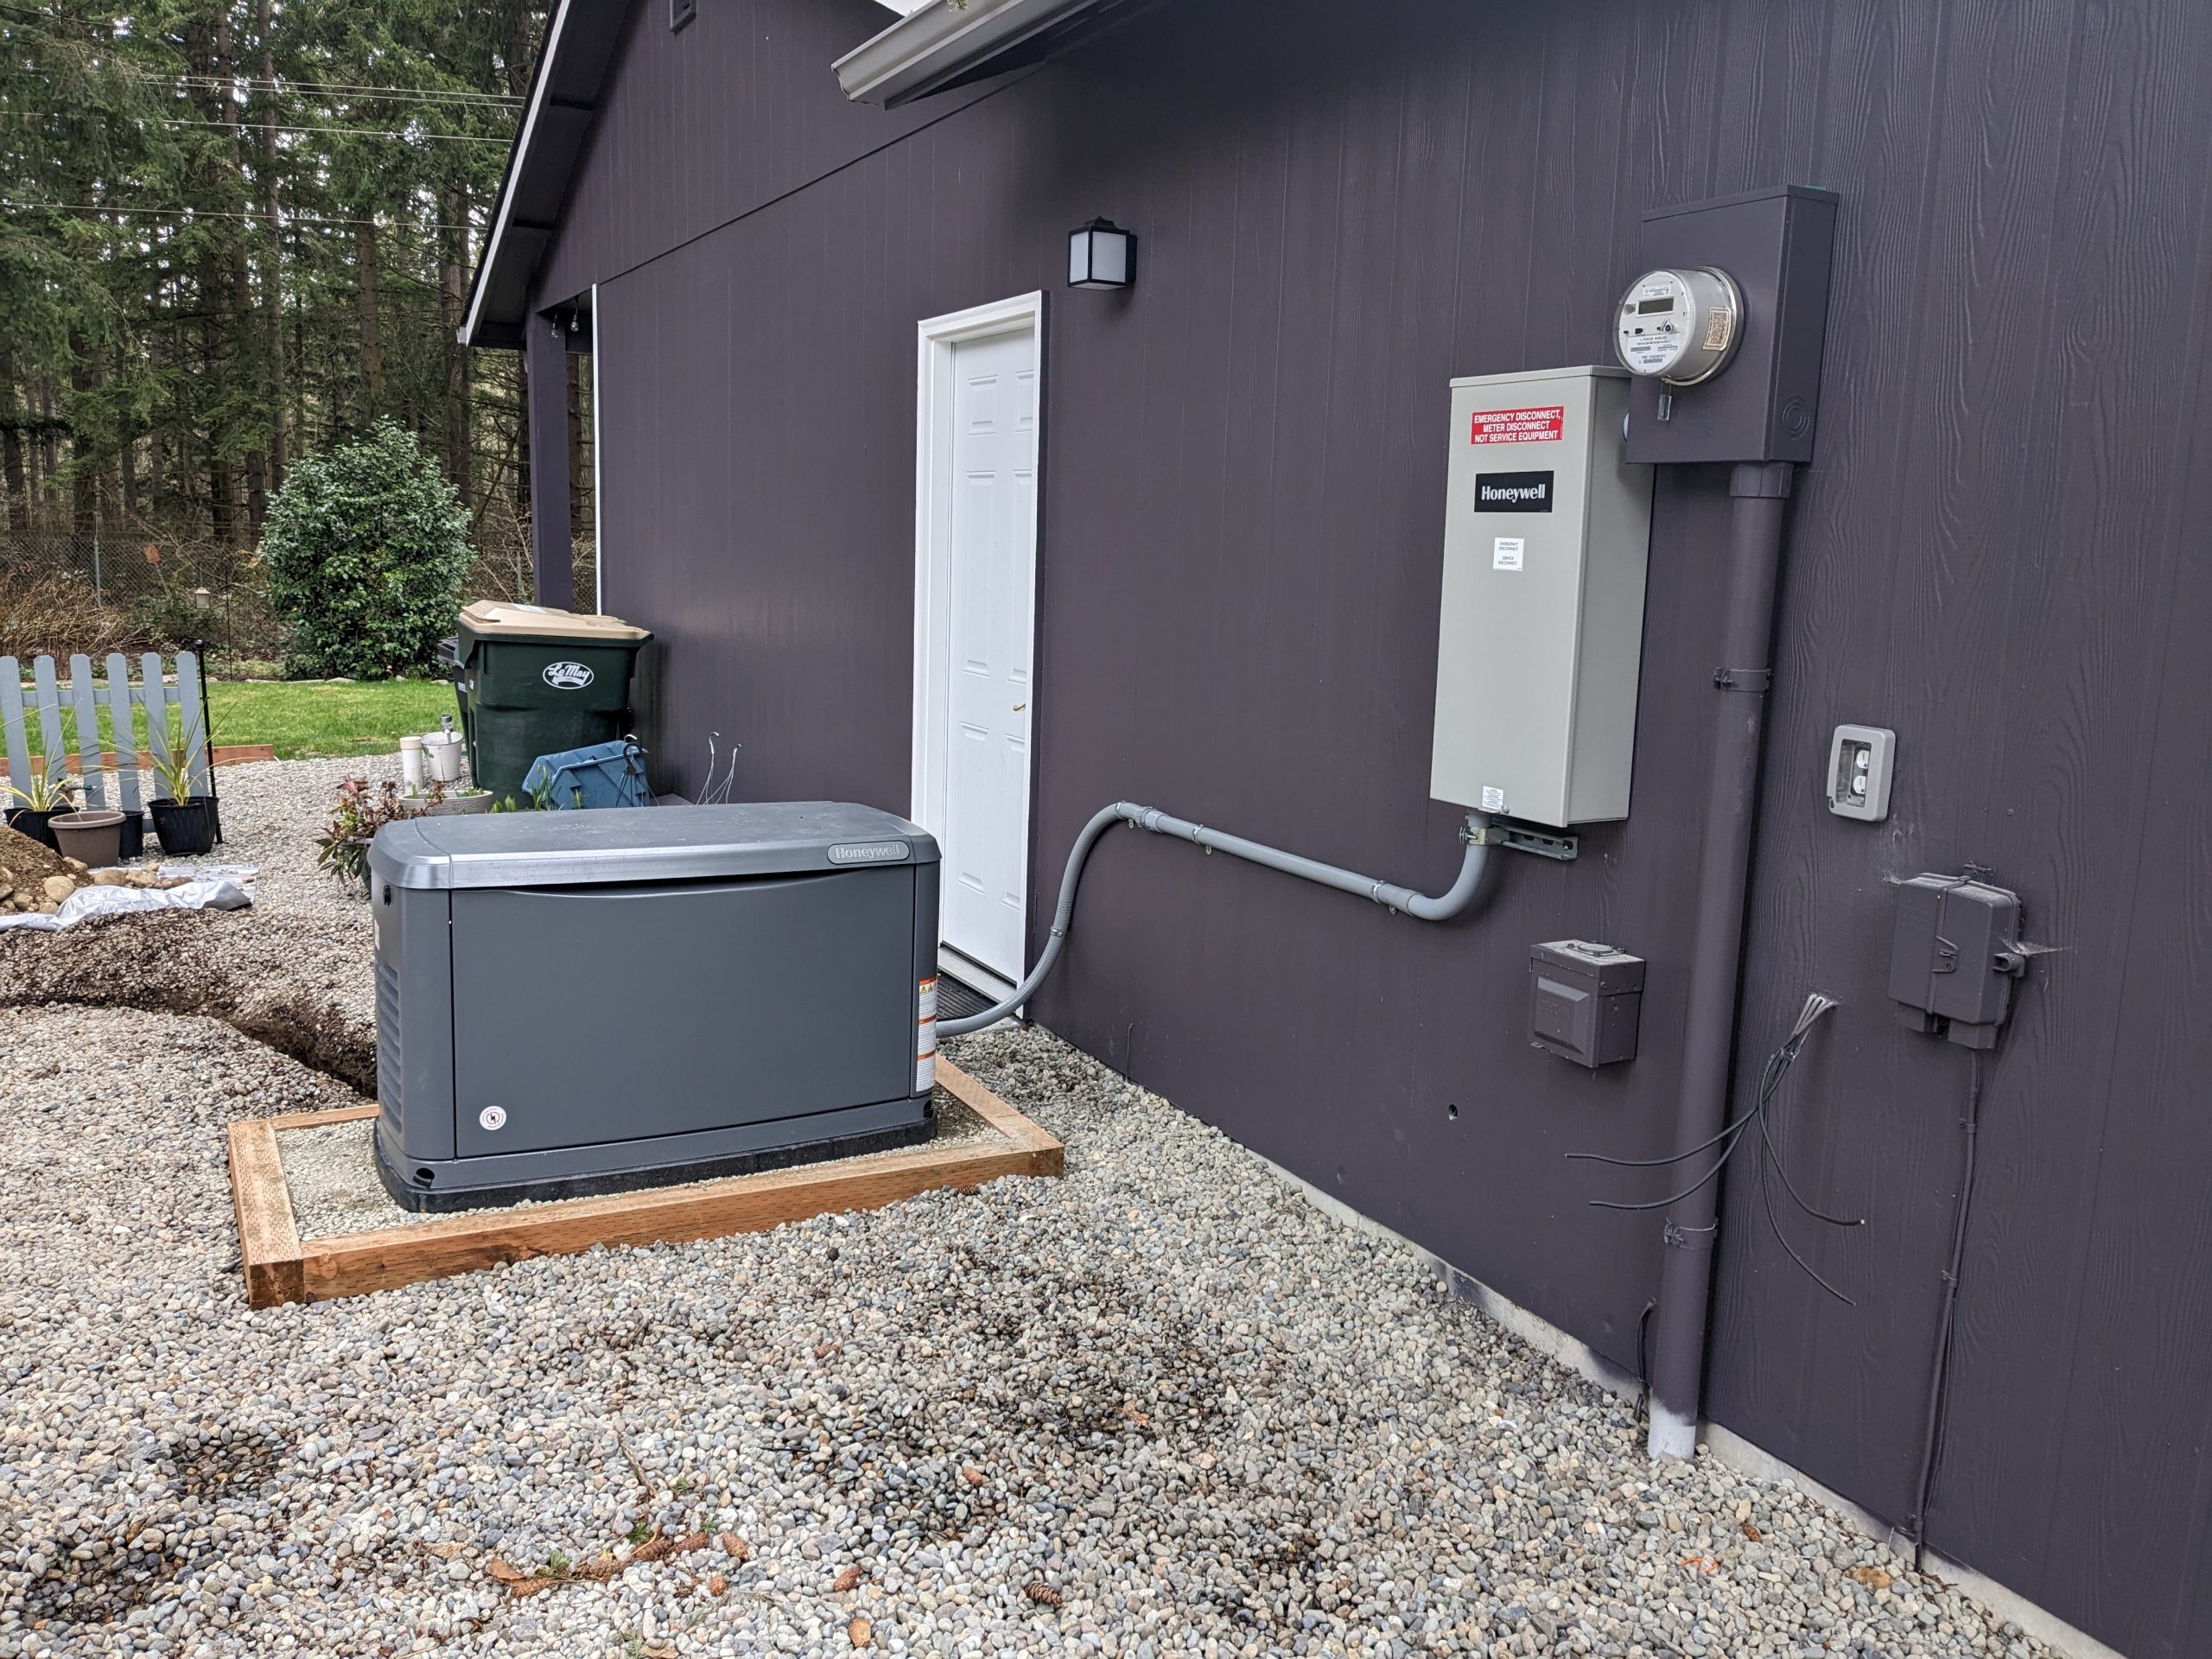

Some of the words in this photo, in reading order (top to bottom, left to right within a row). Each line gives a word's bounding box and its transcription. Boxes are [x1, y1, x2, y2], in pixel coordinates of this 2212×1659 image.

[1474, 412, 1515, 423] EMERGENCY
[1516, 410, 1560, 422] DISCONNECT,
[1483, 423, 1505, 433] METER
[1506, 420, 1550, 432] DISCONNECT
[1474, 434, 1488, 443] NOT
[1489, 432, 1517, 442] SERVICE
[1518, 430, 1559, 442] EQUIPMENT
[1481, 483, 1546, 503] Honeywell
[547, 664, 590, 683] LeMay
[835, 844, 899, 859] Honeywell
